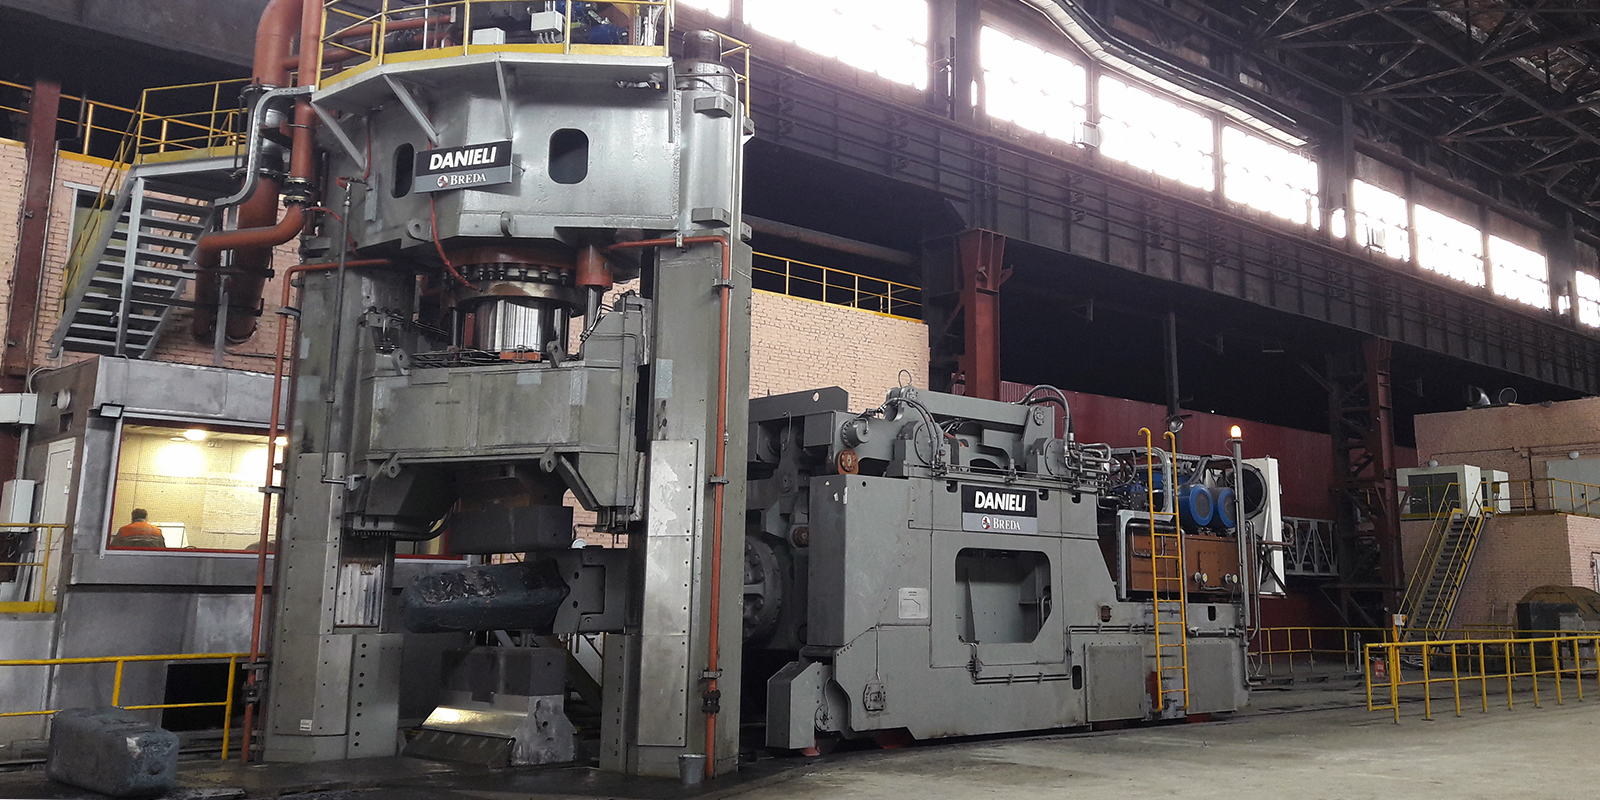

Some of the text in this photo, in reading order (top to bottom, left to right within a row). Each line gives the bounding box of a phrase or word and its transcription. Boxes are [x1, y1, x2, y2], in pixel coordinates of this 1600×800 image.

[429, 146, 497, 171] DANIELI
[450, 173, 487, 186] BREDA
[974, 490, 1027, 512] DANIELI
[993, 517, 1021, 531] BREDA
